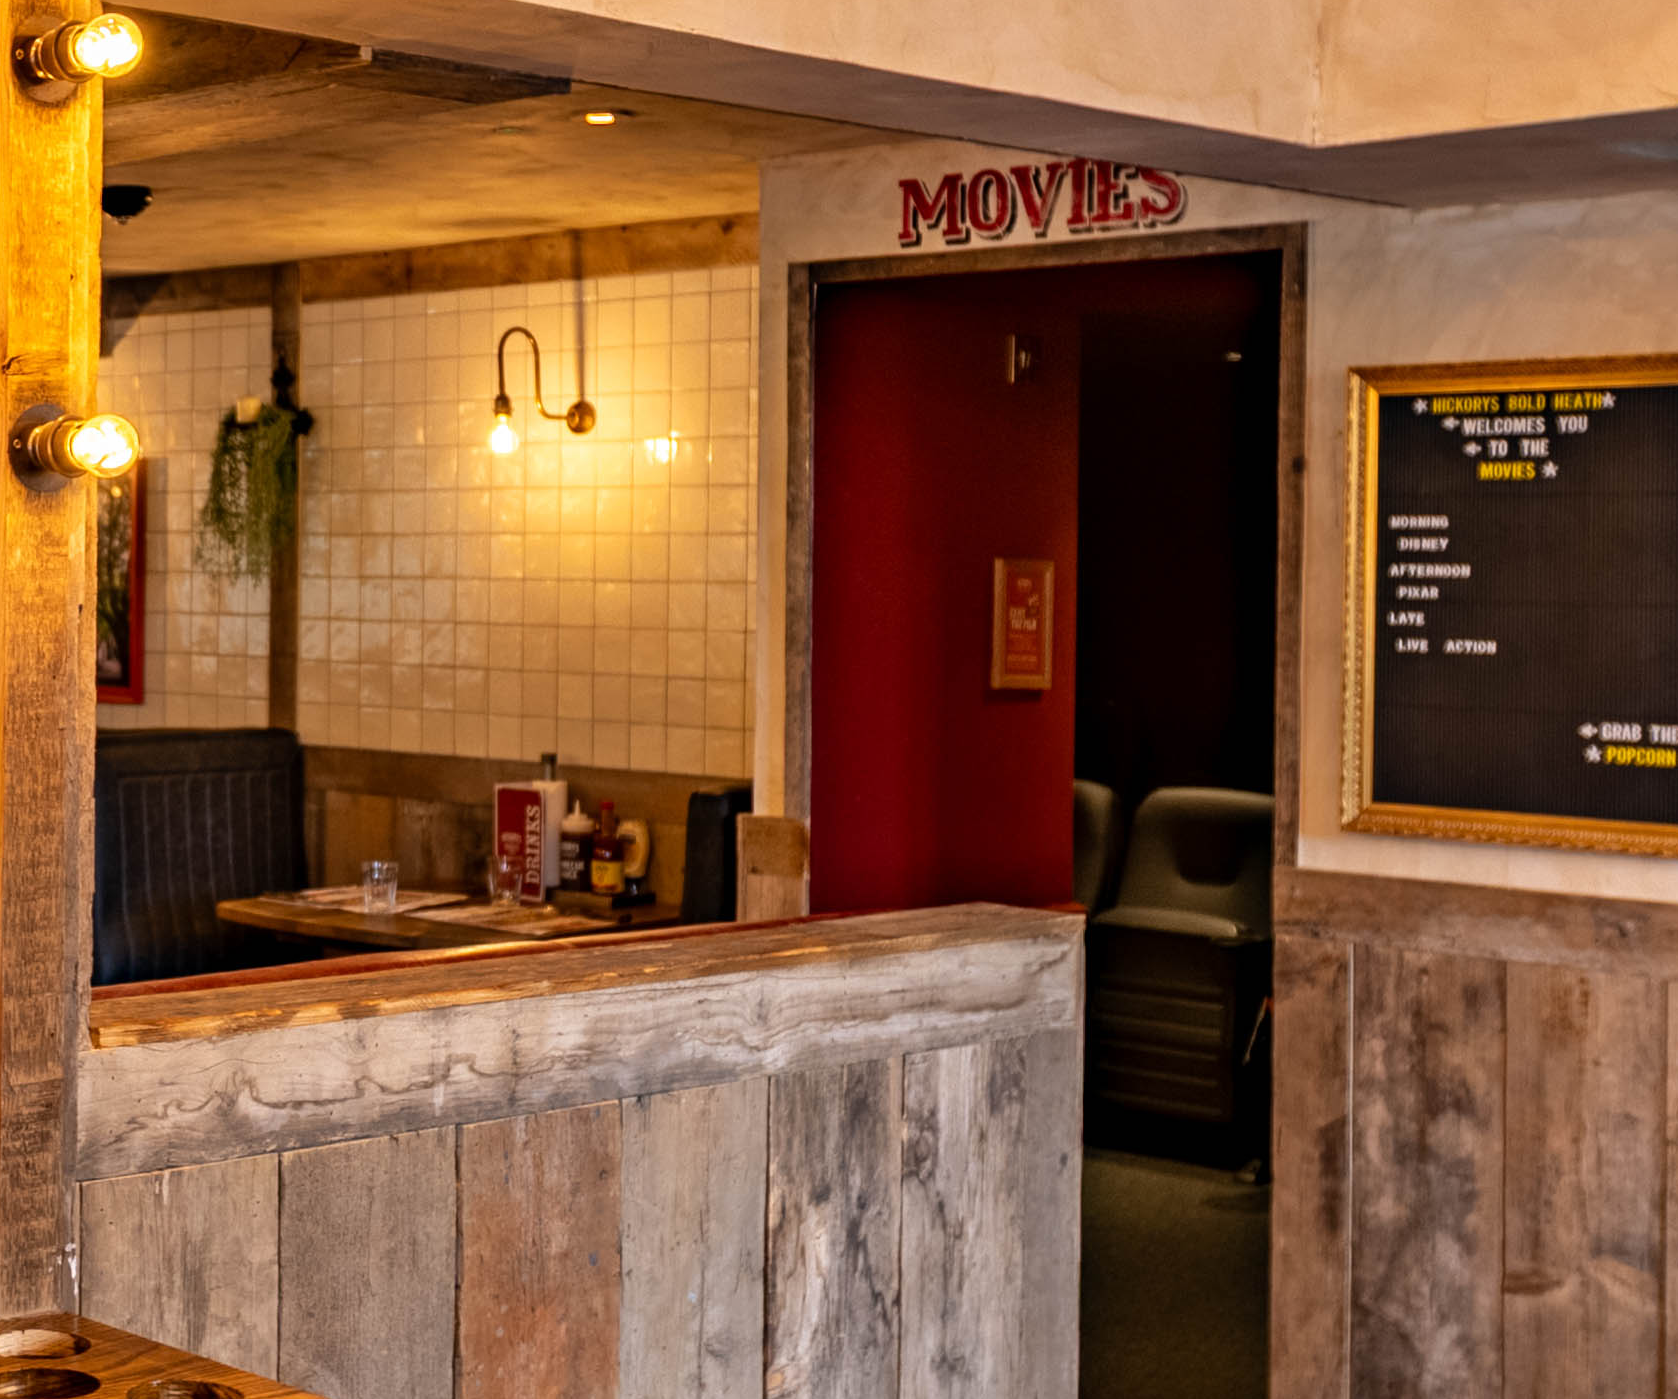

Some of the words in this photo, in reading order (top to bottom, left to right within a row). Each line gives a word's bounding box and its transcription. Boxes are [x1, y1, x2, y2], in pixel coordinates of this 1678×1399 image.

[898, 157, 1184, 247] MOVIES
[1432, 396, 1500, 414] HICKORYS
[1508, 394, 1546, 412] BOLD
[1554, 392, 1603, 411] HEATH
[1462, 417, 1546, 436] WELCOMES
[1557, 415, 1588, 433] YOU
[1488, 439, 1508, 457] TO
[1520, 438, 1550, 457] THE
[1478, 461, 1536, 480] MOVIES
[1389, 514, 1449, 530] MORNING
[1398, 536, 1449, 552] DISNEY
[1389, 563, 1472, 579] AFTERNOON
[1397, 585, 1440, 600] PIXAR
[1388, 611, 1425, 627] LATE
[1396, 637, 1429, 653] LIVE
[1444, 638, 1497, 655] ACTION
[1599, 721, 1643, 742] GRAB
[1604, 745, 1677, 768] POPCORN
[525, 804, 541, 884] DRINKS
